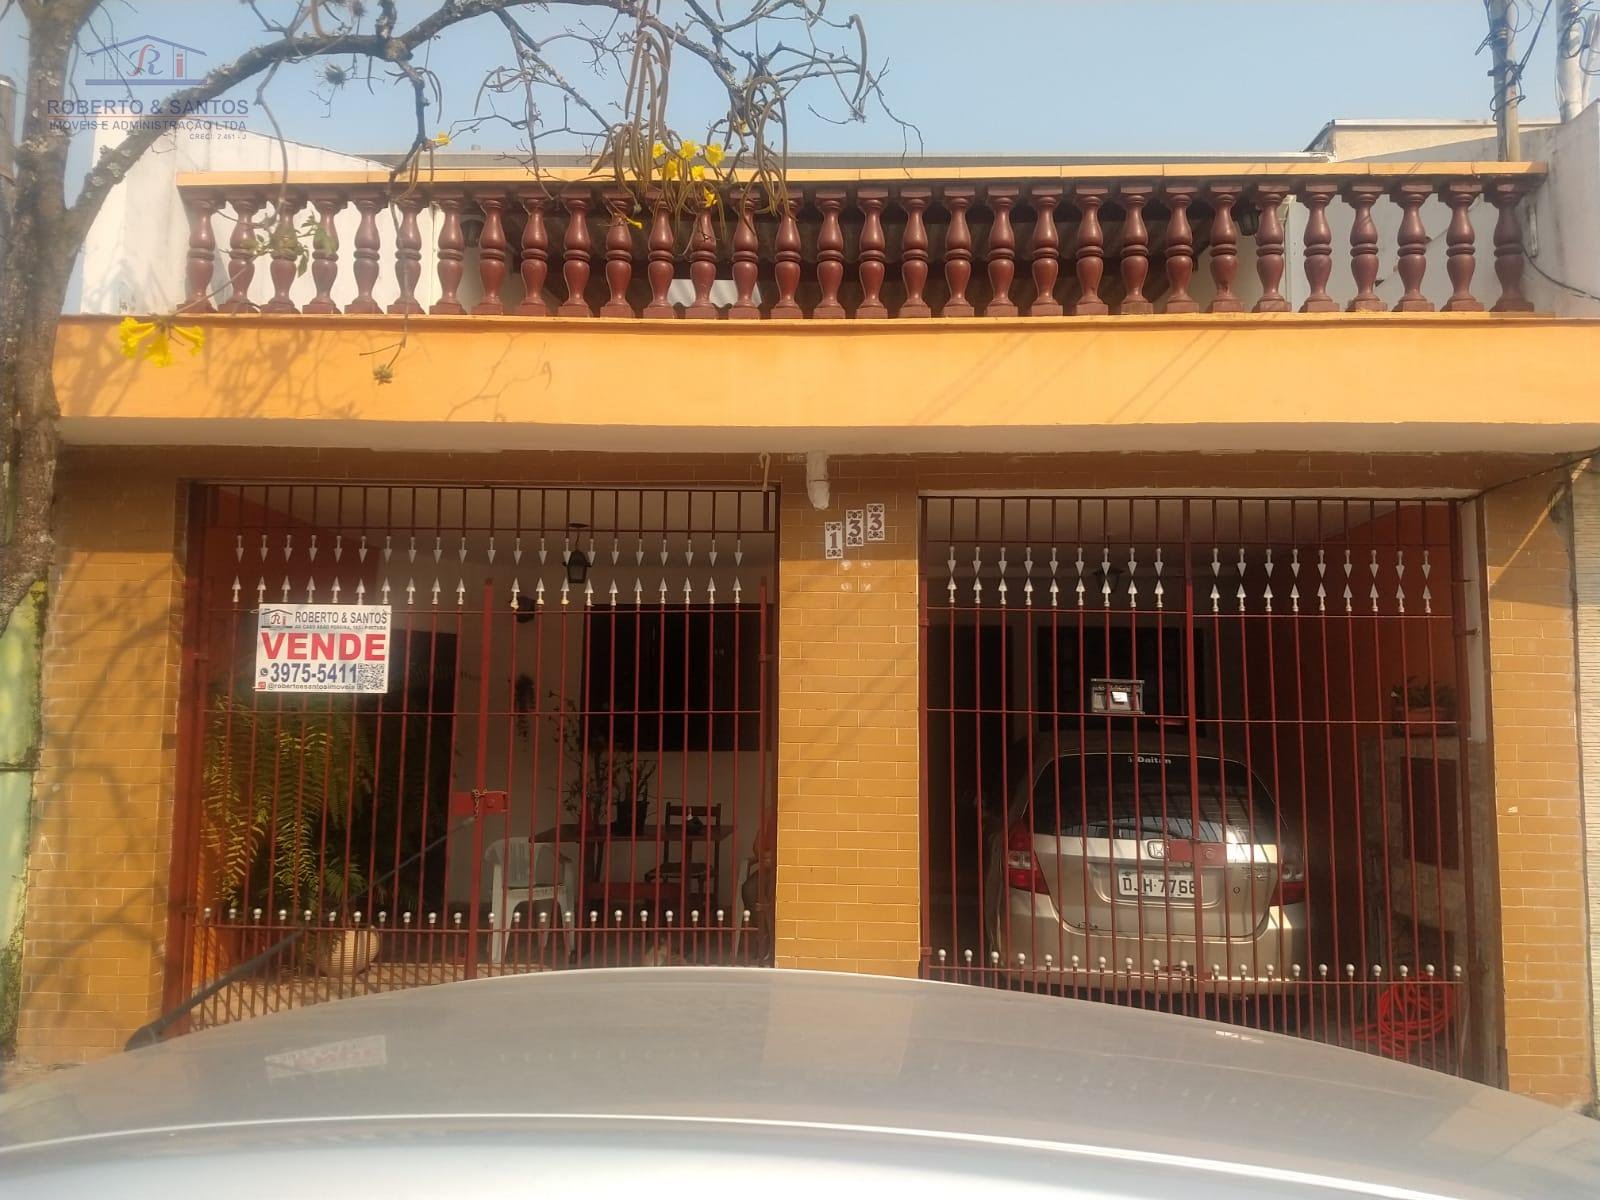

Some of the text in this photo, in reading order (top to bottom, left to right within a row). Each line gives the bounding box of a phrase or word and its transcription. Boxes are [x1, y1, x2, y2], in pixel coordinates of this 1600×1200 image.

[294, 611, 388, 625] ROBERTO & SANTOS
[261, 632, 386, 661] VENDE
[270, 662, 357, 683] 3975-5411
